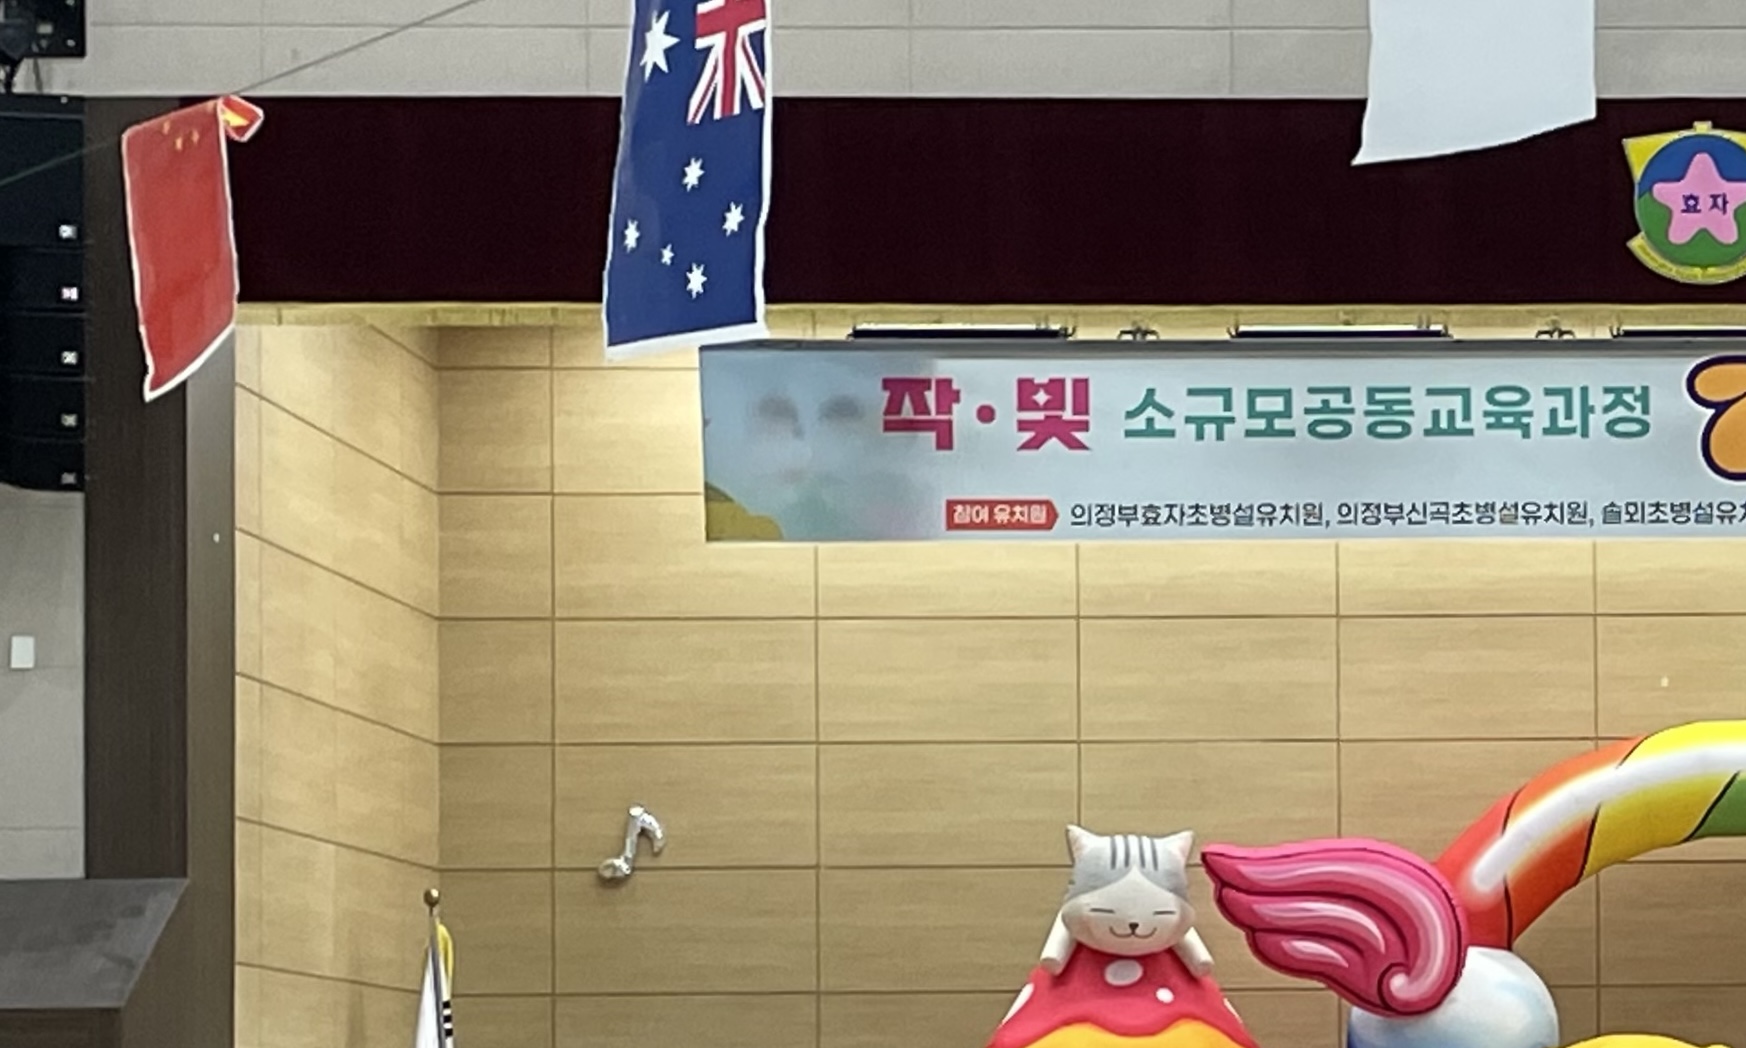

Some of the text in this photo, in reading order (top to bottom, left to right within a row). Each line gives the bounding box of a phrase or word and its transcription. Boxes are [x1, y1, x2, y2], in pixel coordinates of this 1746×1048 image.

[1123, 384, 1653, 440] 소규모공동교육과정
[993, 504, 1048, 524] 유치원
[1070, 502, 1332, 528] 의정부효자초병설유치원,
[1336, 501, 1595, 527] 의정부신곡초병설유치원,
